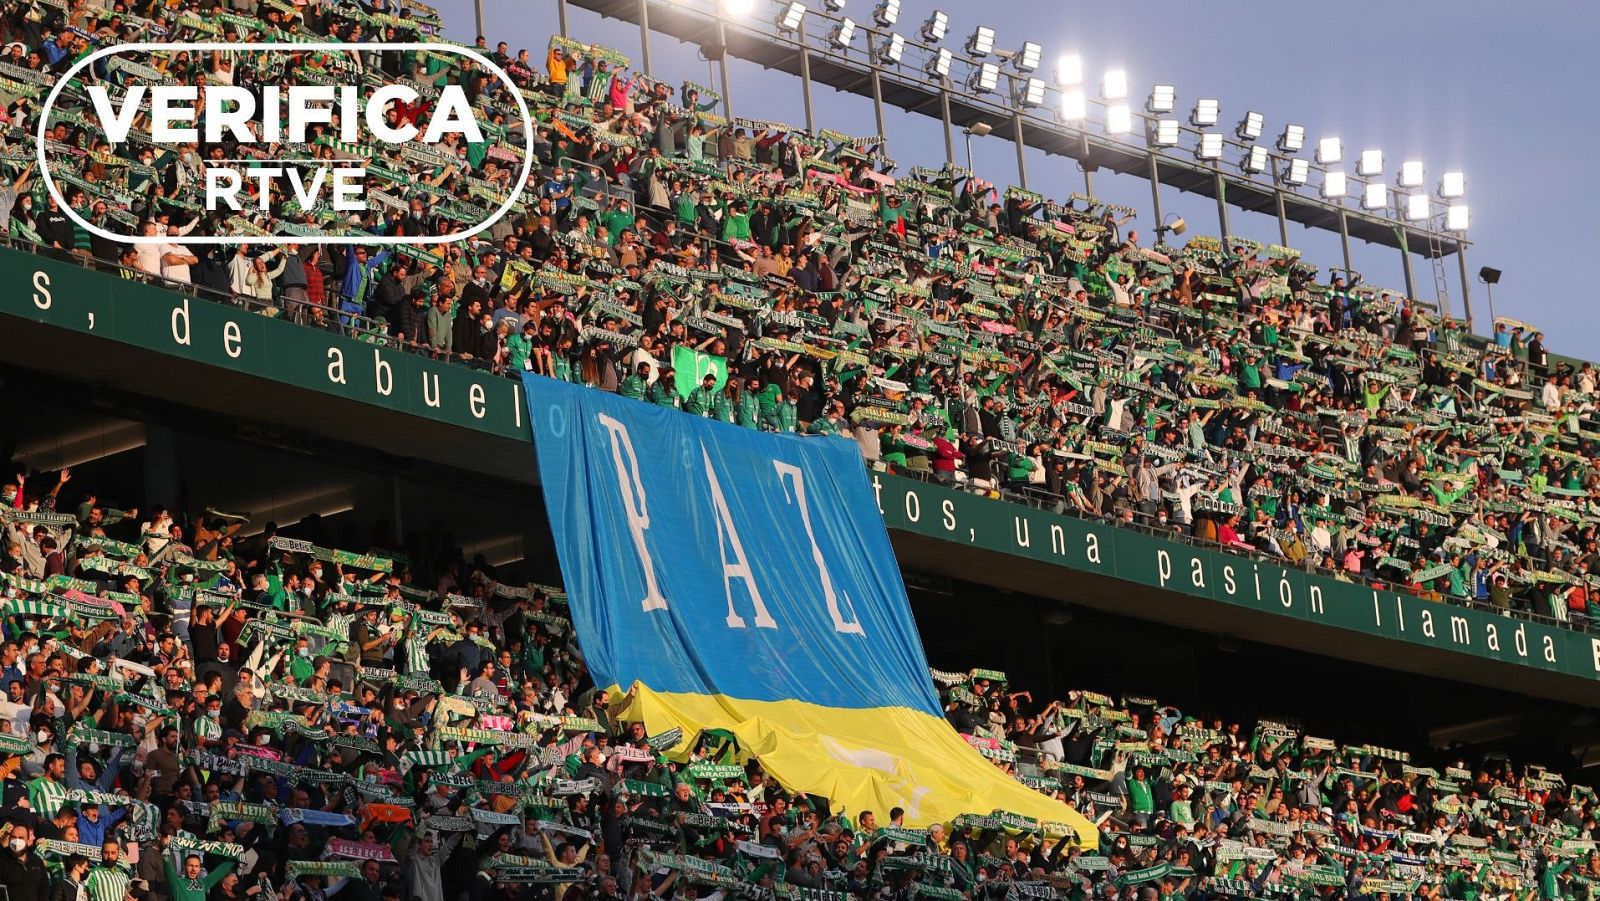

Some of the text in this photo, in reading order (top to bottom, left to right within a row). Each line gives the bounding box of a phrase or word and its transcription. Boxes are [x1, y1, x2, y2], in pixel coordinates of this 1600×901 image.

[171, 298, 242, 358] de
[1015, 516, 1101, 564] una
[1157, 551, 1324, 615] pasión
[1373, 591, 1557, 663] llamada
[598, 411, 867, 638] PAZ
